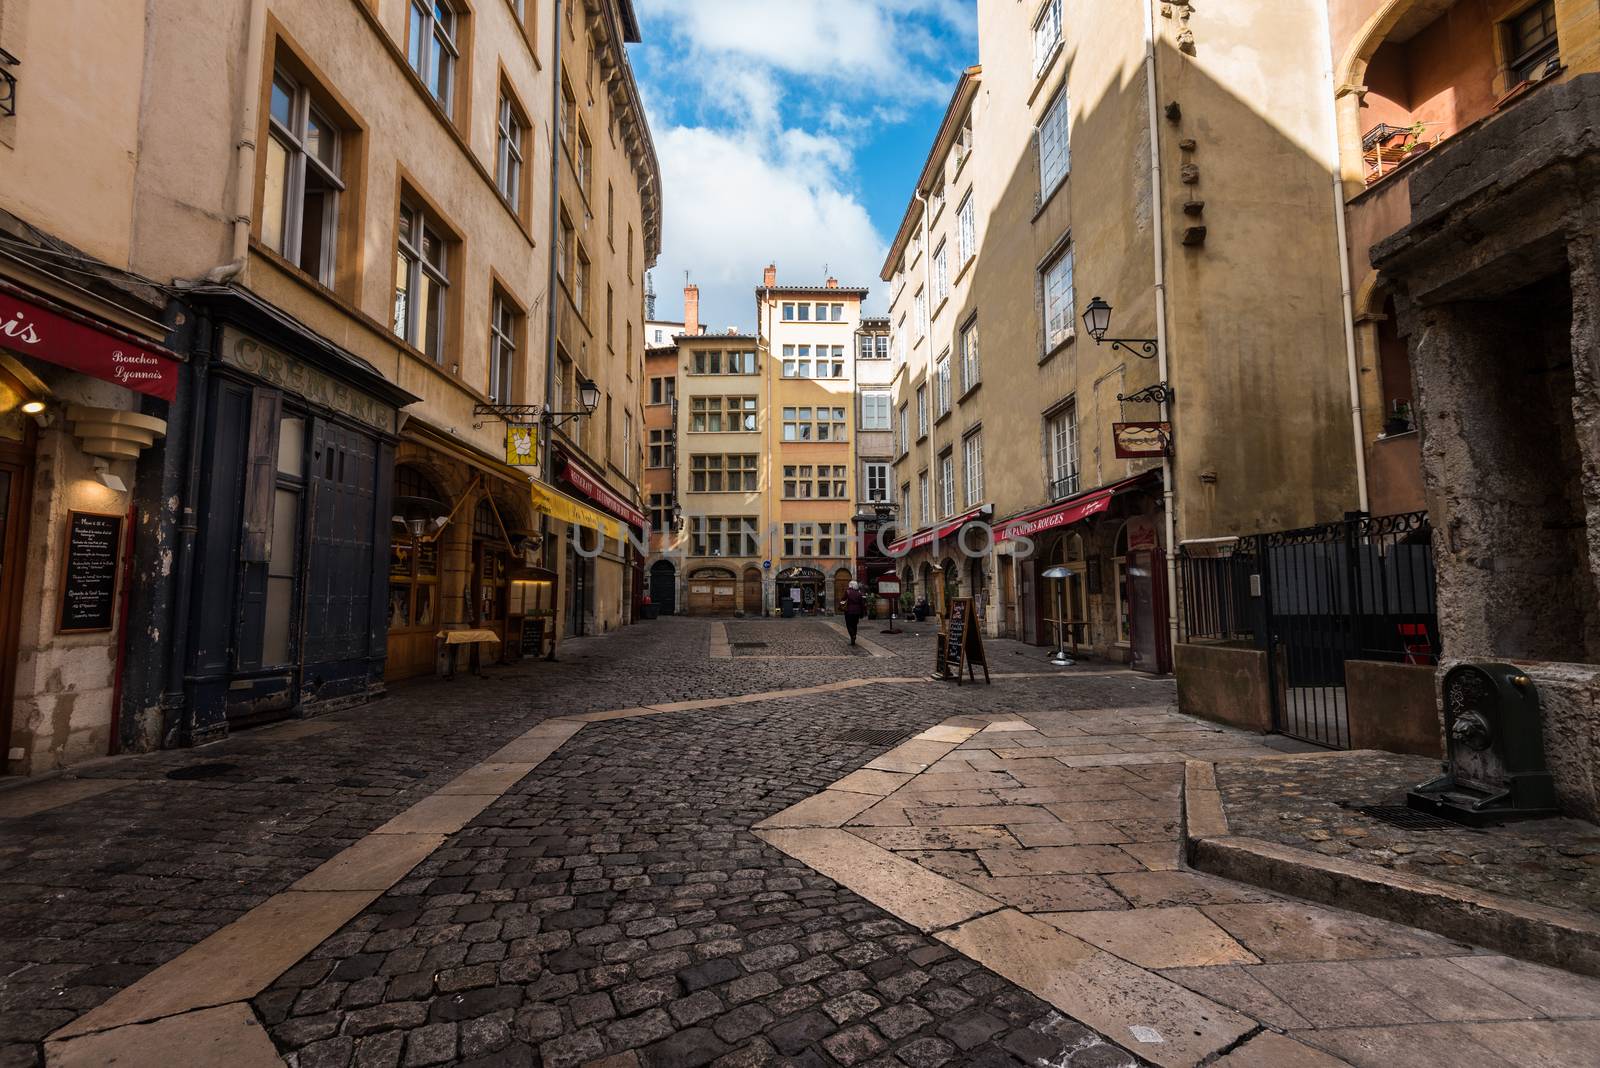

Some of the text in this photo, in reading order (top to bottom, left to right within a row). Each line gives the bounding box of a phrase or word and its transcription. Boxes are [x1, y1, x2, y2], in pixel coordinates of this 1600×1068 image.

[0, 311, 41, 344] is
[112, 350, 158, 365] Bouchon
[114, 365, 162, 382] Lyonnais
[1038, 512, 1065, 529] ROUGES
